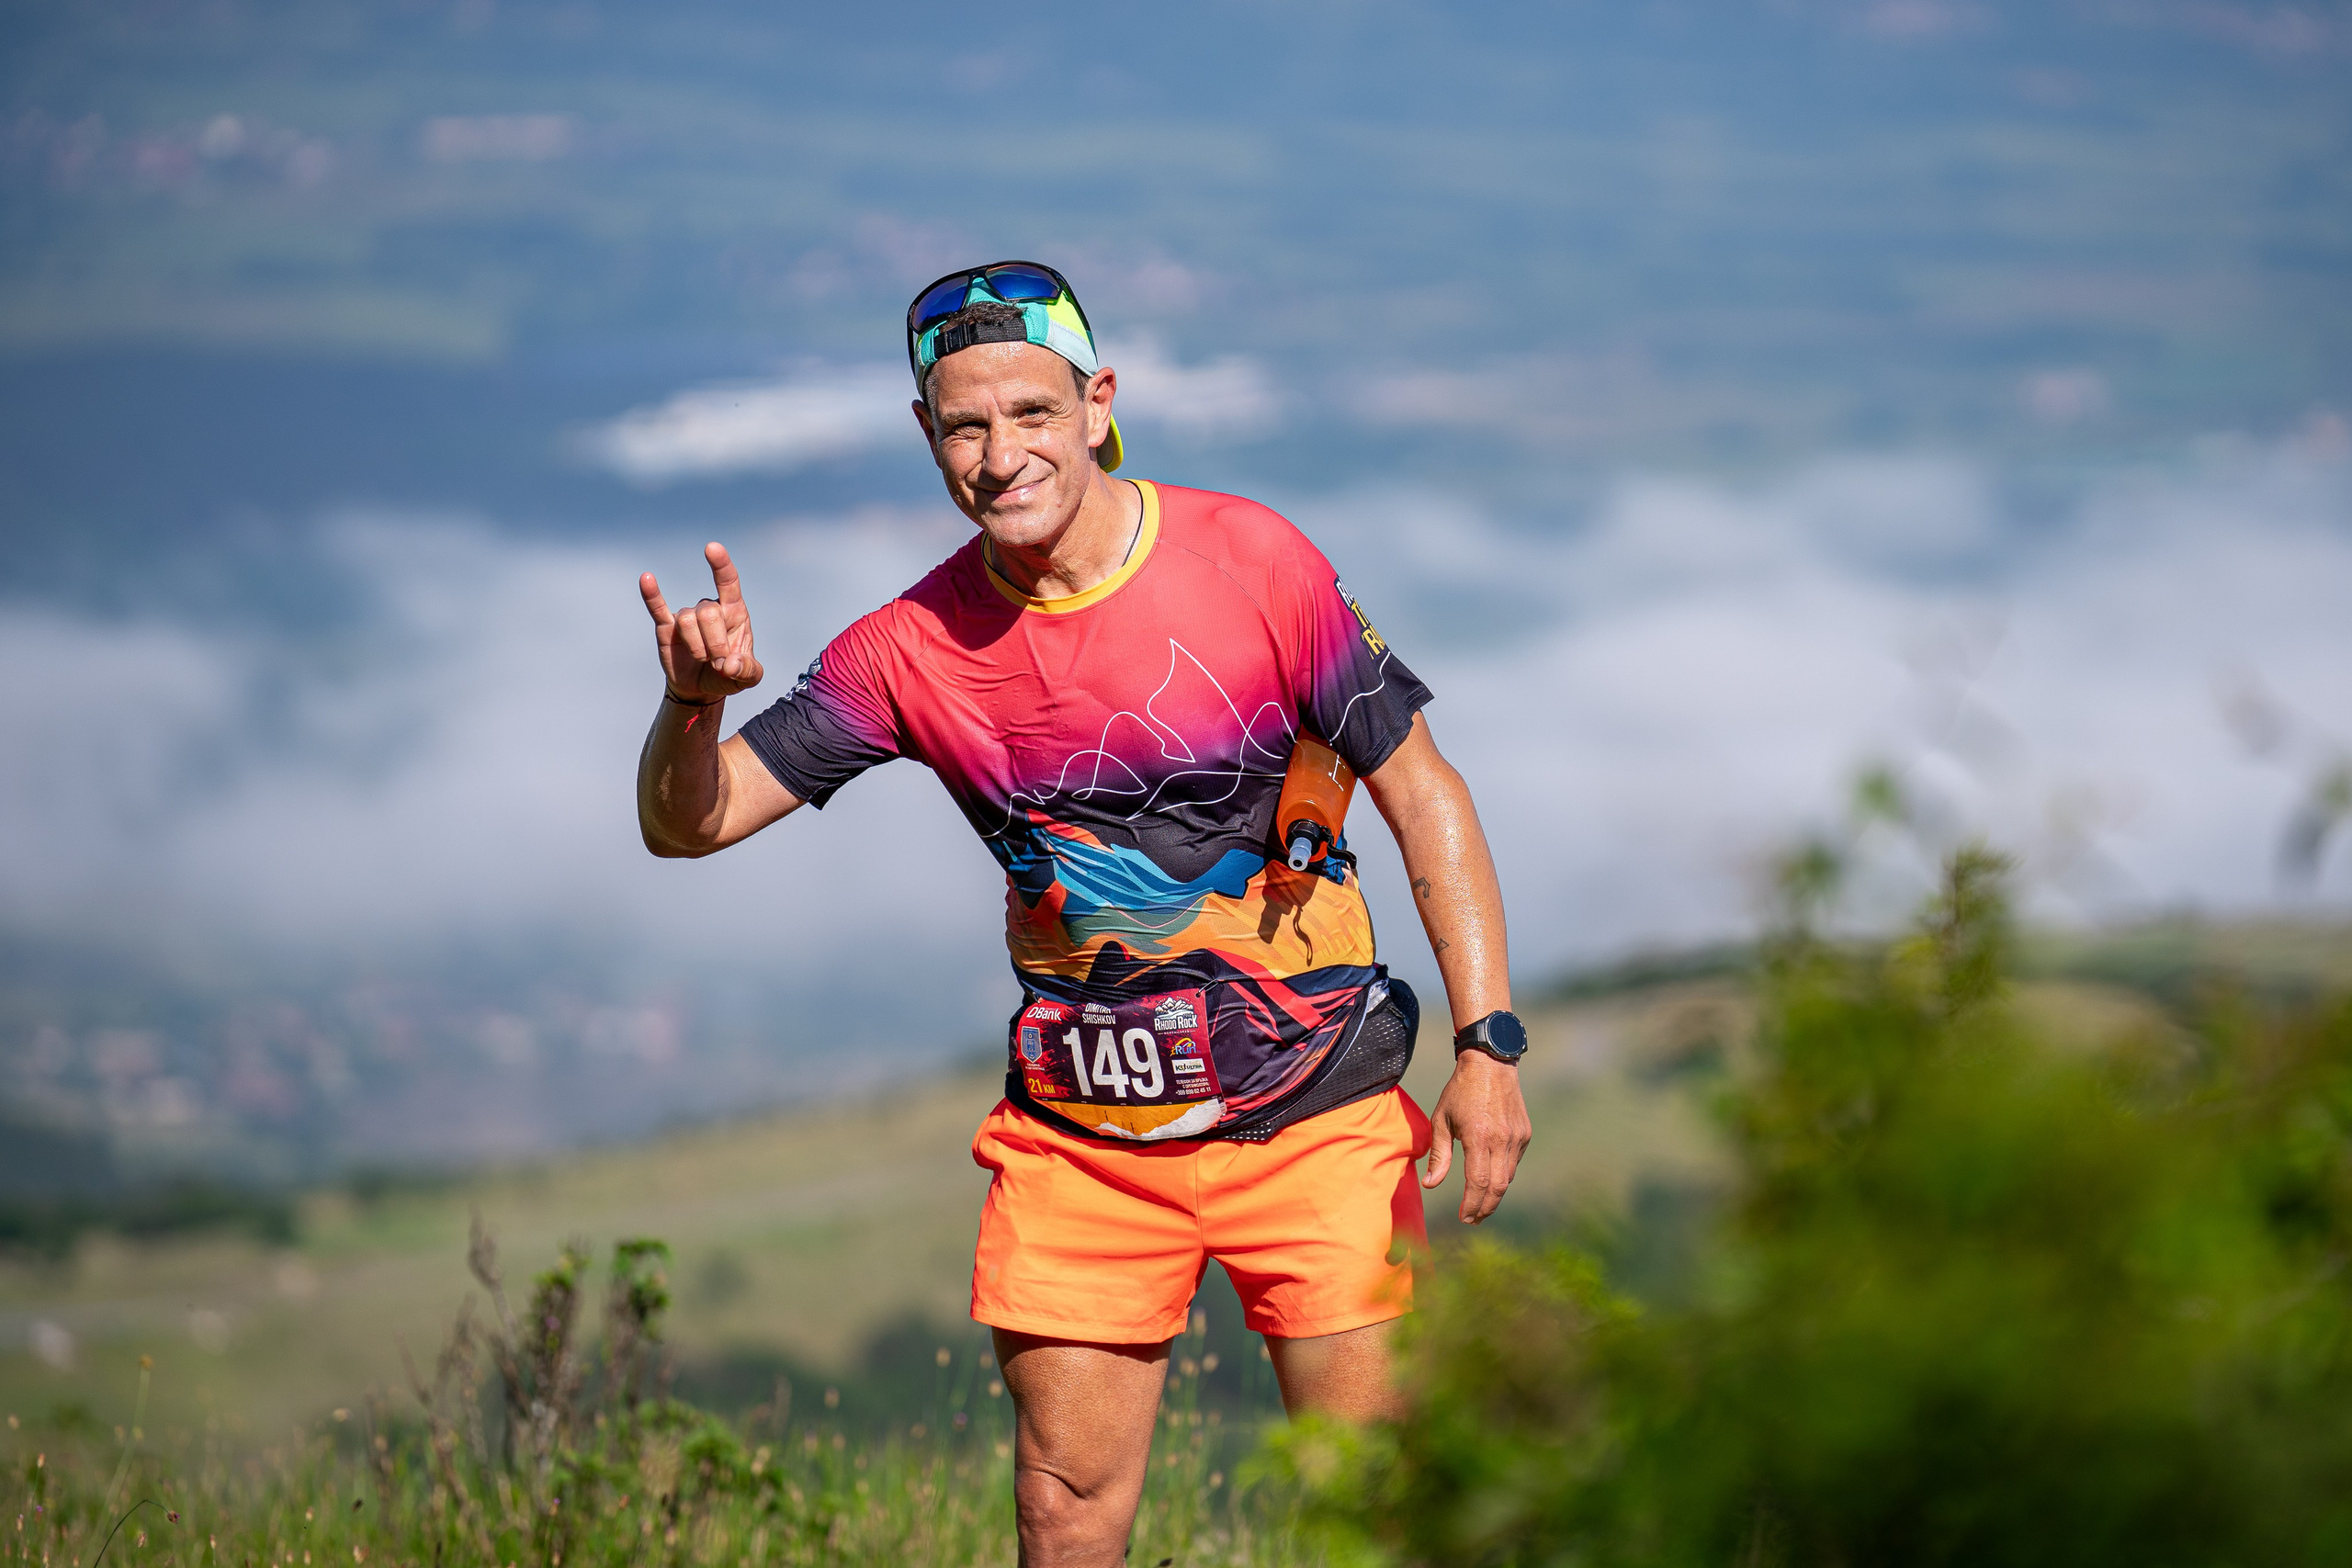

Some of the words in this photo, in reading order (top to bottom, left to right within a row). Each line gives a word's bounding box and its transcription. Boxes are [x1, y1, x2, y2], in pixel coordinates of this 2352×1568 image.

[1026, 1006, 1062, 1021] DBank
[1081, 1013, 1116, 1024] SHISHKOV
[1177, 1014, 1198, 1029] ROCK
[1062, 1027, 1165, 1099] 149
[1028, 1077, 1043, 1093] 21
[1043, 1084, 1056, 1094] KM
